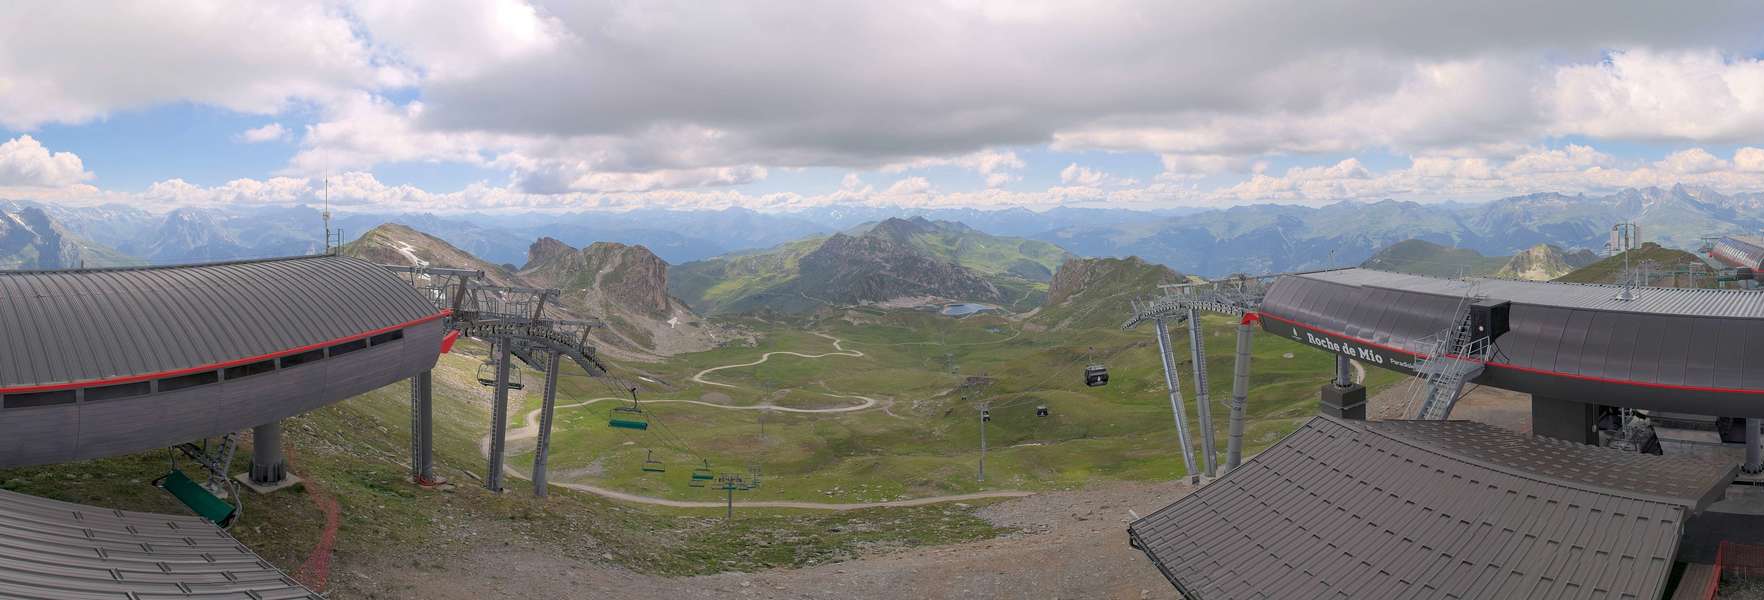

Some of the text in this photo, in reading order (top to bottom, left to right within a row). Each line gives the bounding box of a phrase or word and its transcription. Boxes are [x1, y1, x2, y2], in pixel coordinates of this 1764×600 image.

[1307, 333, 1383, 364] Roche de Mio
